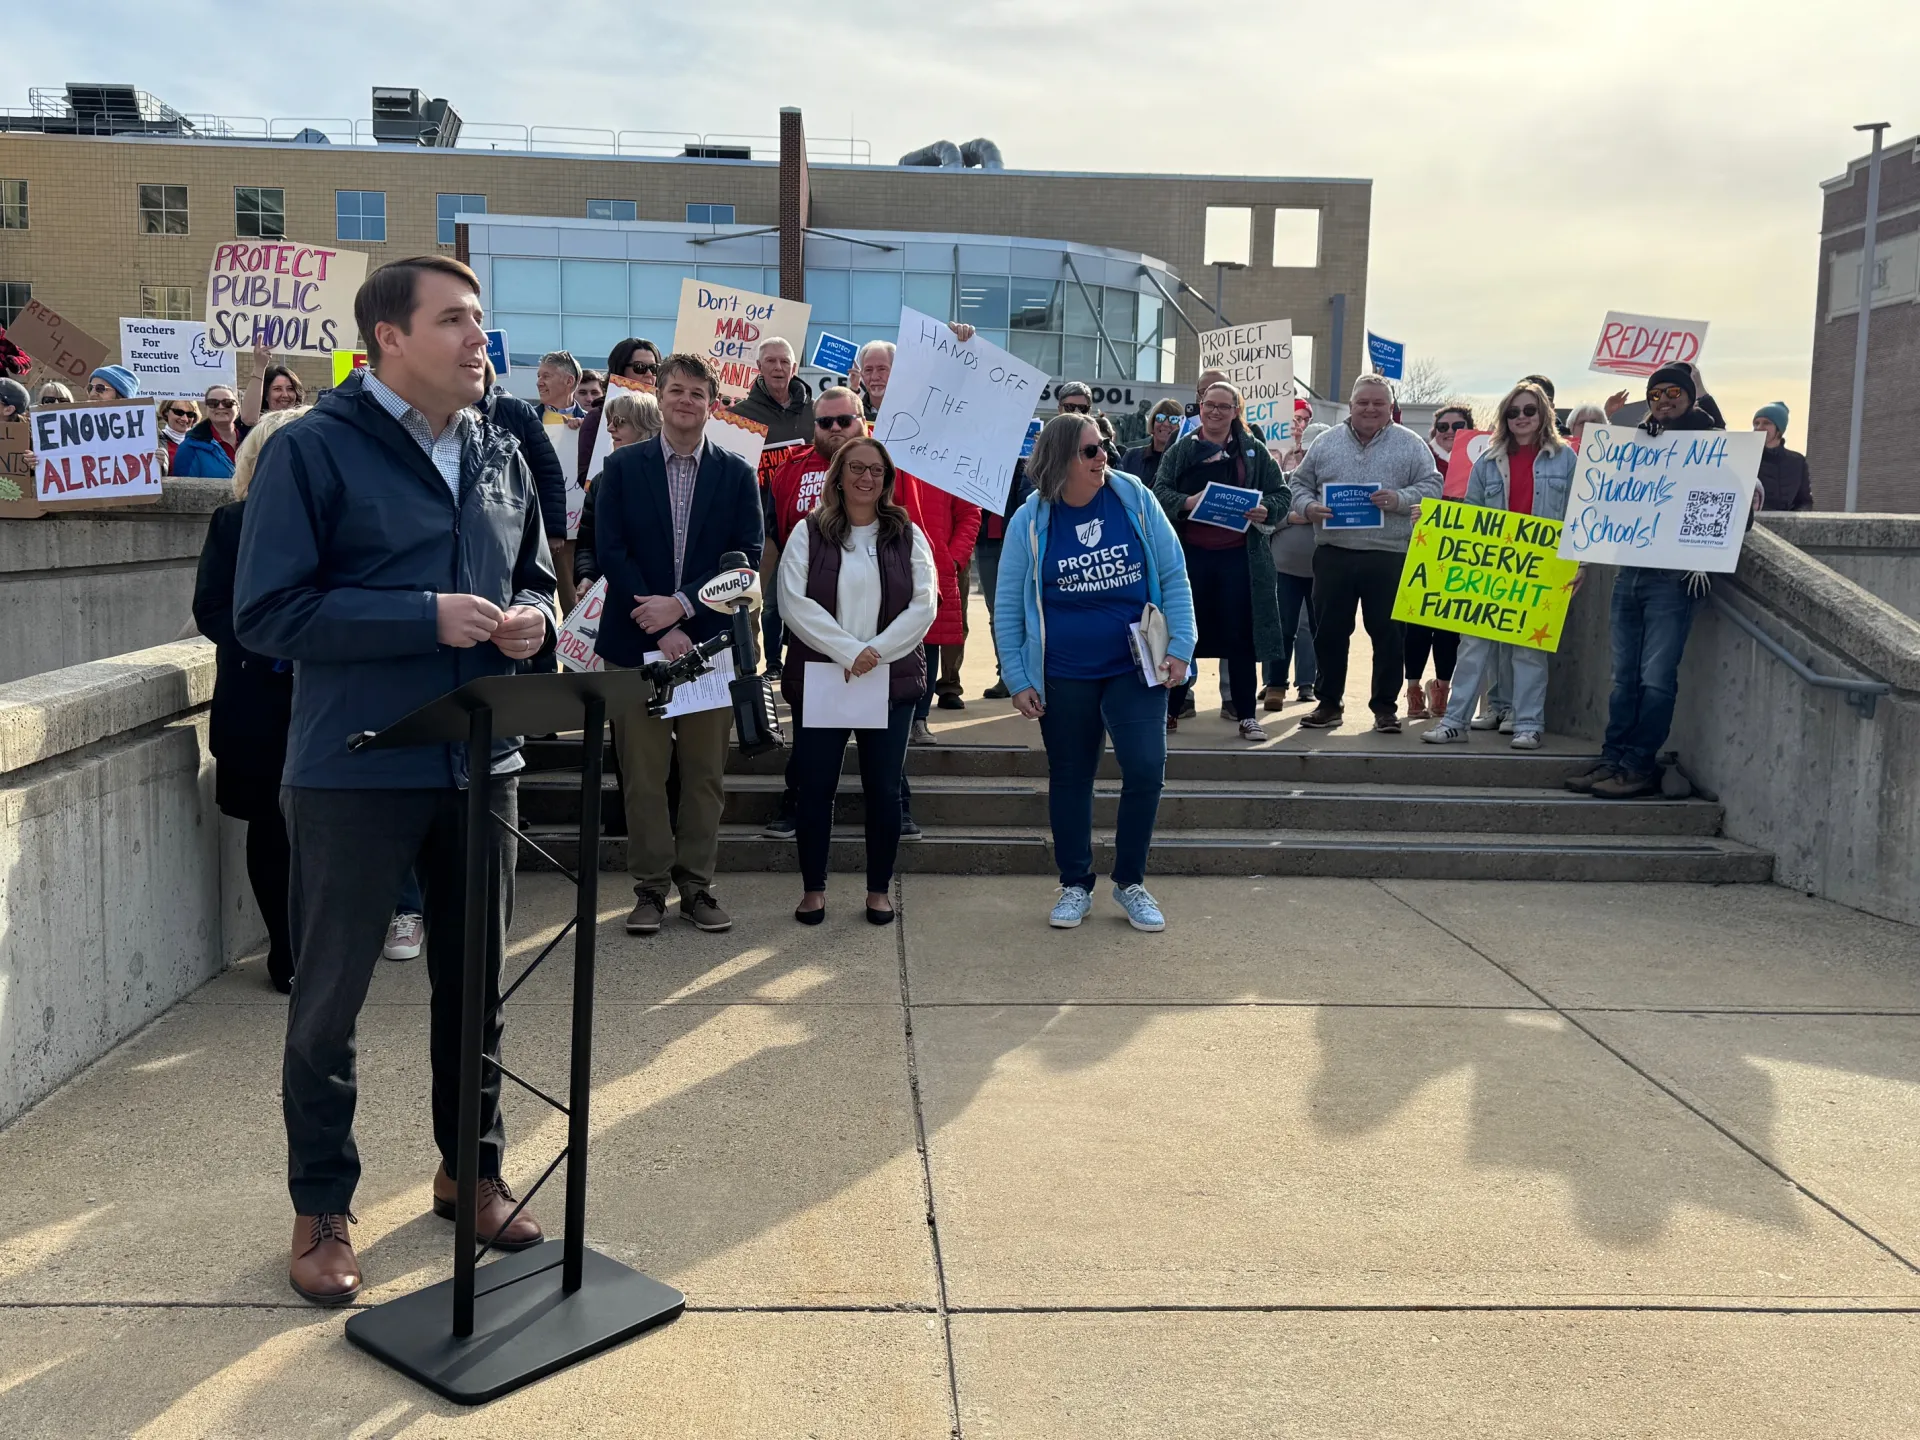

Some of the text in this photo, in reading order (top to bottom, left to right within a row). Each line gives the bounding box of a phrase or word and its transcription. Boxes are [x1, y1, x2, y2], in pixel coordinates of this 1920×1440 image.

[214, 243, 337, 281] PROTECT
[212, 274, 322, 313] PUBLIC
[697, 288, 775, 321] Don't get
[26, 300, 62, 328] RED
[50, 330, 64, 351] 4
[126, 324, 175, 335] Teachers
[142, 338, 160, 347] For
[209, 310, 339, 353] SCHOOLS
[714, 317, 760, 342] MAD
[1201, 324, 1267, 353] PROTECT
[131, 350, 179, 360] Executive
[708, 340, 751, 358] get
[920, 320, 1028, 390] HANDS OFF
[1202, 343, 1292, 368] OUR STUDENTS
[55, 350, 87, 377] ED
[133, 363, 180, 373] Function
[922, 385, 968, 417] THE
[36, 409, 145, 451] ENOUGH
[930, 448, 949, 461] of
[1587, 429, 1728, 472] Support NH
[42, 452, 159, 494] ALREADY.
[796, 497, 812, 512] OF
[1214, 492, 1250, 506] PROTECT
[1424, 504, 1465, 530] ALL
[1472, 510, 1507, 538] NH
[1058, 544, 1129, 573] PROTECT
[1437, 536, 1544, 578] DESERVE
[1057, 560, 1142, 585] OUR KIDS AND
[1059, 570, 1142, 592] COMMUNITIES
[1407, 562, 1553, 607] A BRIGHT
[704, 578, 741, 597] WMUR
[1420, 591, 1528, 633] FUTURE!
